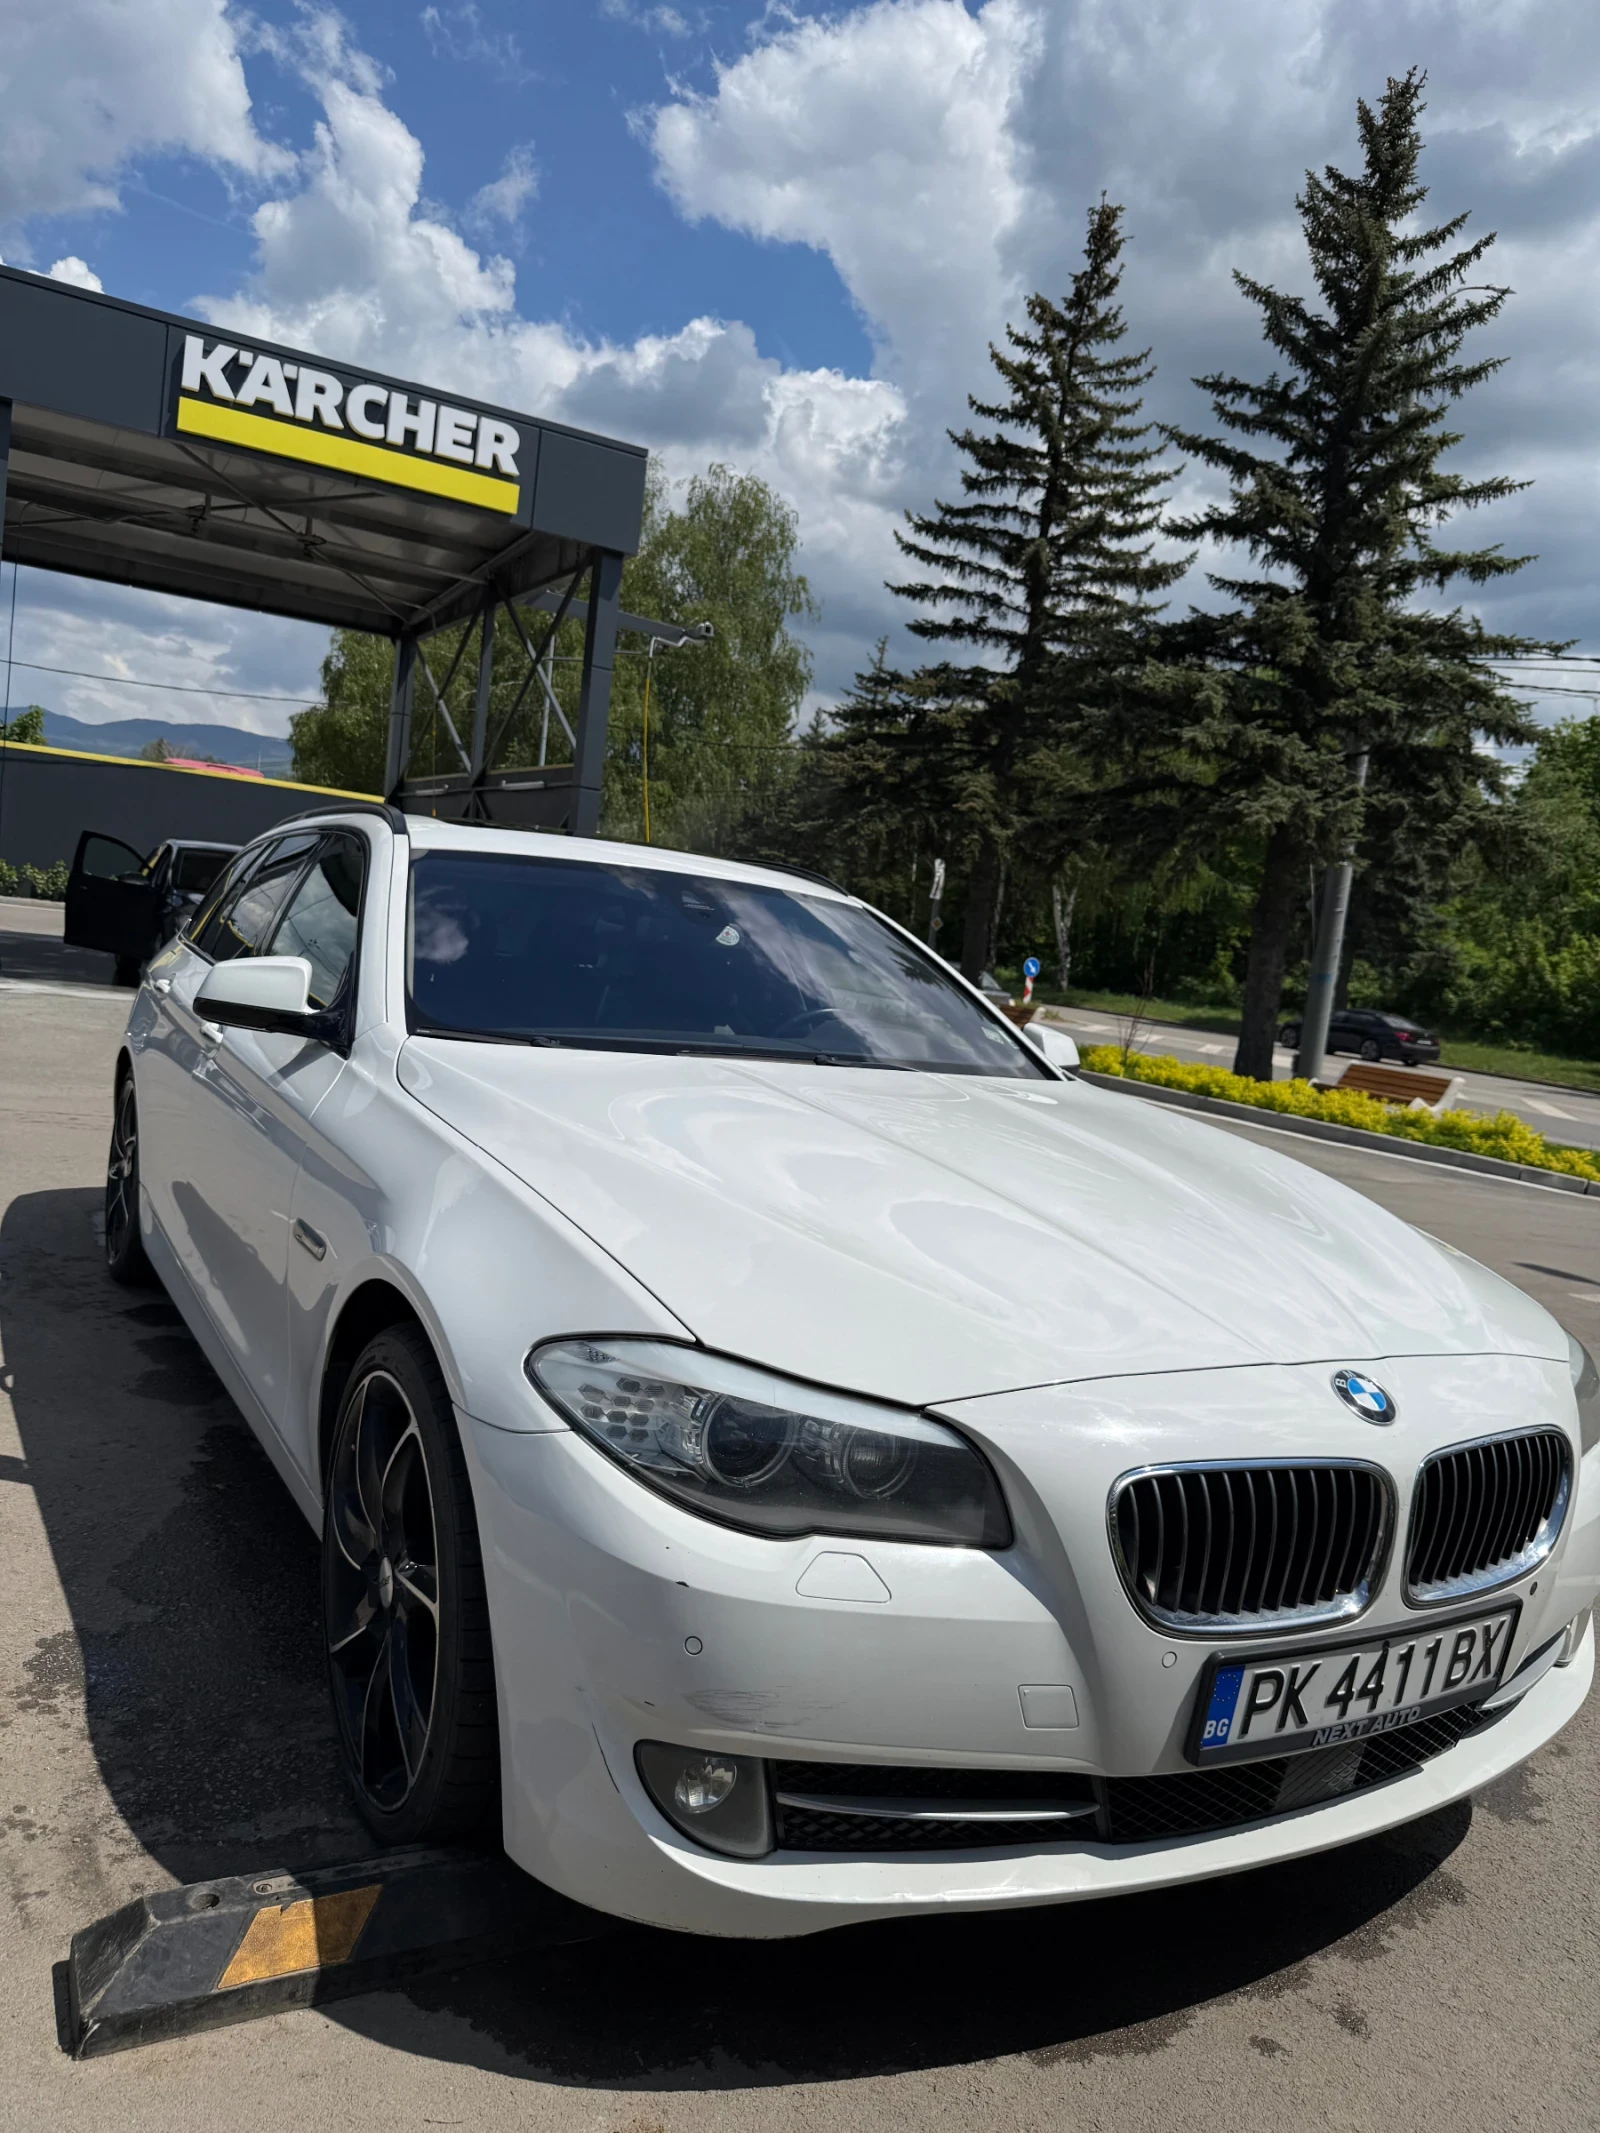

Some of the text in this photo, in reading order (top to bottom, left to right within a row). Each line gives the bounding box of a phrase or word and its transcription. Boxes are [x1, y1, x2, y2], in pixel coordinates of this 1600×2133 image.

[181, 335, 520, 476] KÄRCHER
[1238, 1617, 1507, 1739] PK 4411 BX
[1203, 1718, 1229, 1739] BG
[1311, 1706, 1421, 1747] NEXT AUTO
